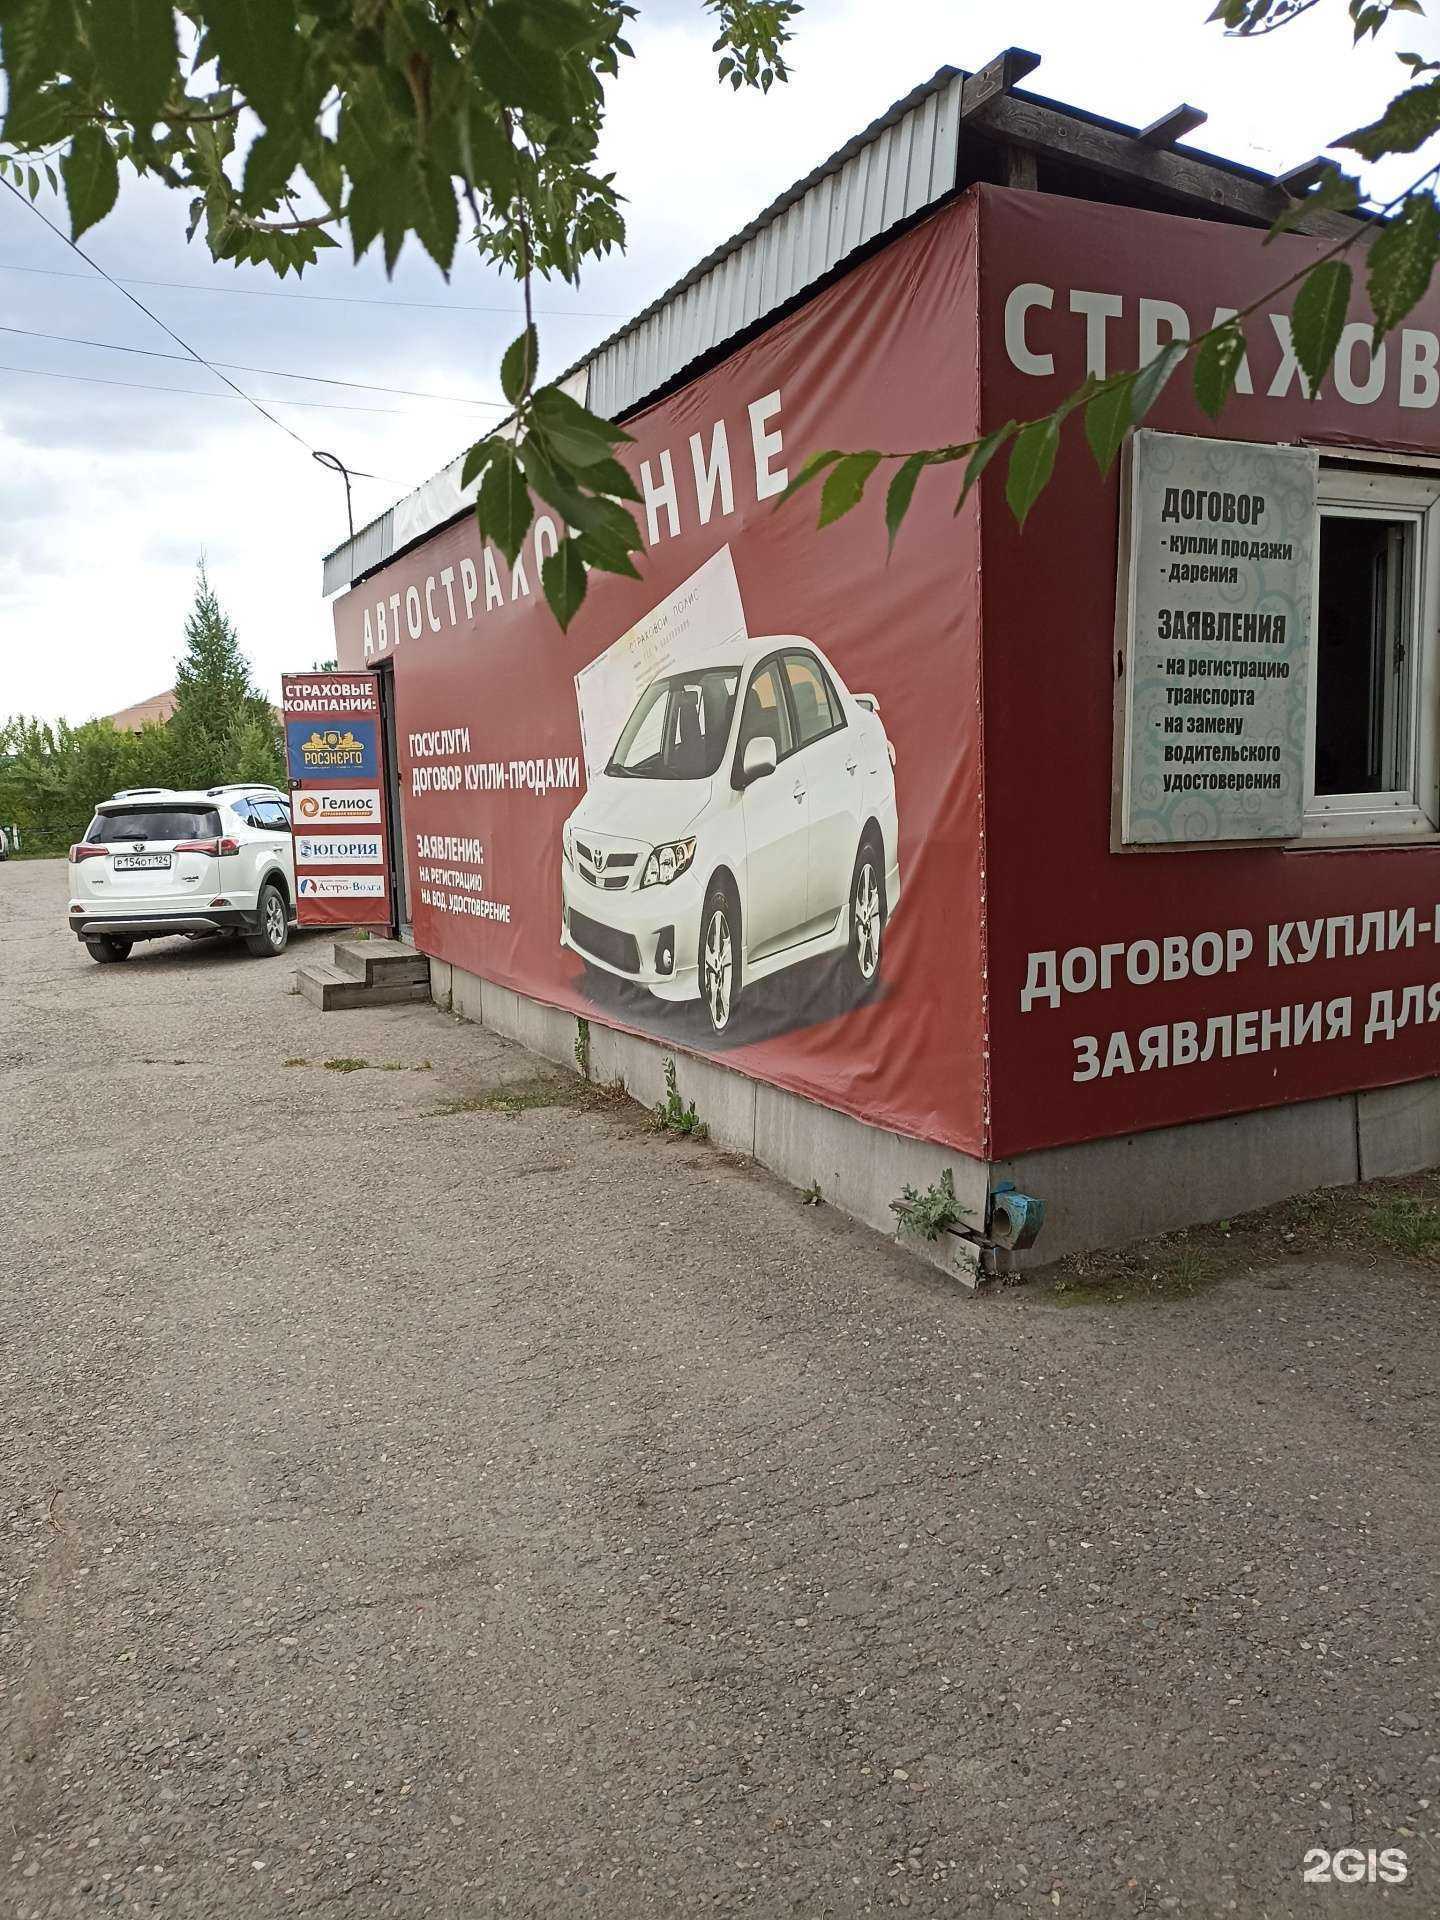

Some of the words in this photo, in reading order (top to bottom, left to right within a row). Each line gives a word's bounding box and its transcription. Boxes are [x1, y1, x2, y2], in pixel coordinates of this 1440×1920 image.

[1161, 487, 1266, 525] ДОГОВОР
[1169, 535, 1219, 556] купли
[1221, 538, 1293, 561] продажи
[1168, 564, 1239, 584] дарения
[1157, 609, 1287, 644] ЗАЯВЛЕНИЯ
[1166, 659, 1186, 676] на
[1188, 659, 1290, 680] регистрацию
[285, 683, 374, 697] СТРАХОВЫЕ
[1166, 687, 1256, 707] транспорта
[284, 698, 377, 712] КОМПАНИИ:
[1164, 718, 1184, 734] на
[1186, 717, 1243, 736] замену
[408, 728, 471, 758] ГОСУСЛУГИ
[304, 751, 363, 765] РОСЭНЕРГО
[1164, 745, 1281, 764] водительского
[412, 765, 462, 797] ДОГОВОР
[464, 757, 580, 796] КУПЛИ-ПРОДАЖИ
[1163, 773, 1281, 792] удостоверения
[322, 796, 373, 810] Гелиос
[313, 843, 377, 856] ЮГОРИЯ
[416, 834, 484, 864] ЗАЯВЛЕНИЯ:
[319, 882, 381, 893] Астро-Волга
[419, 866, 430, 882] НА
[430, 870, 483, 892] РЕГИСТРАЦИЮ
[421, 888, 432, 904] НА
[448, 893, 511, 923] УДОСТОВЕРЕНИЕ
[1020, 928, 1254, 1013] ДОГОВОР
[1072, 995, 1352, 1083] ЗАЯВЛЕНИЯ
